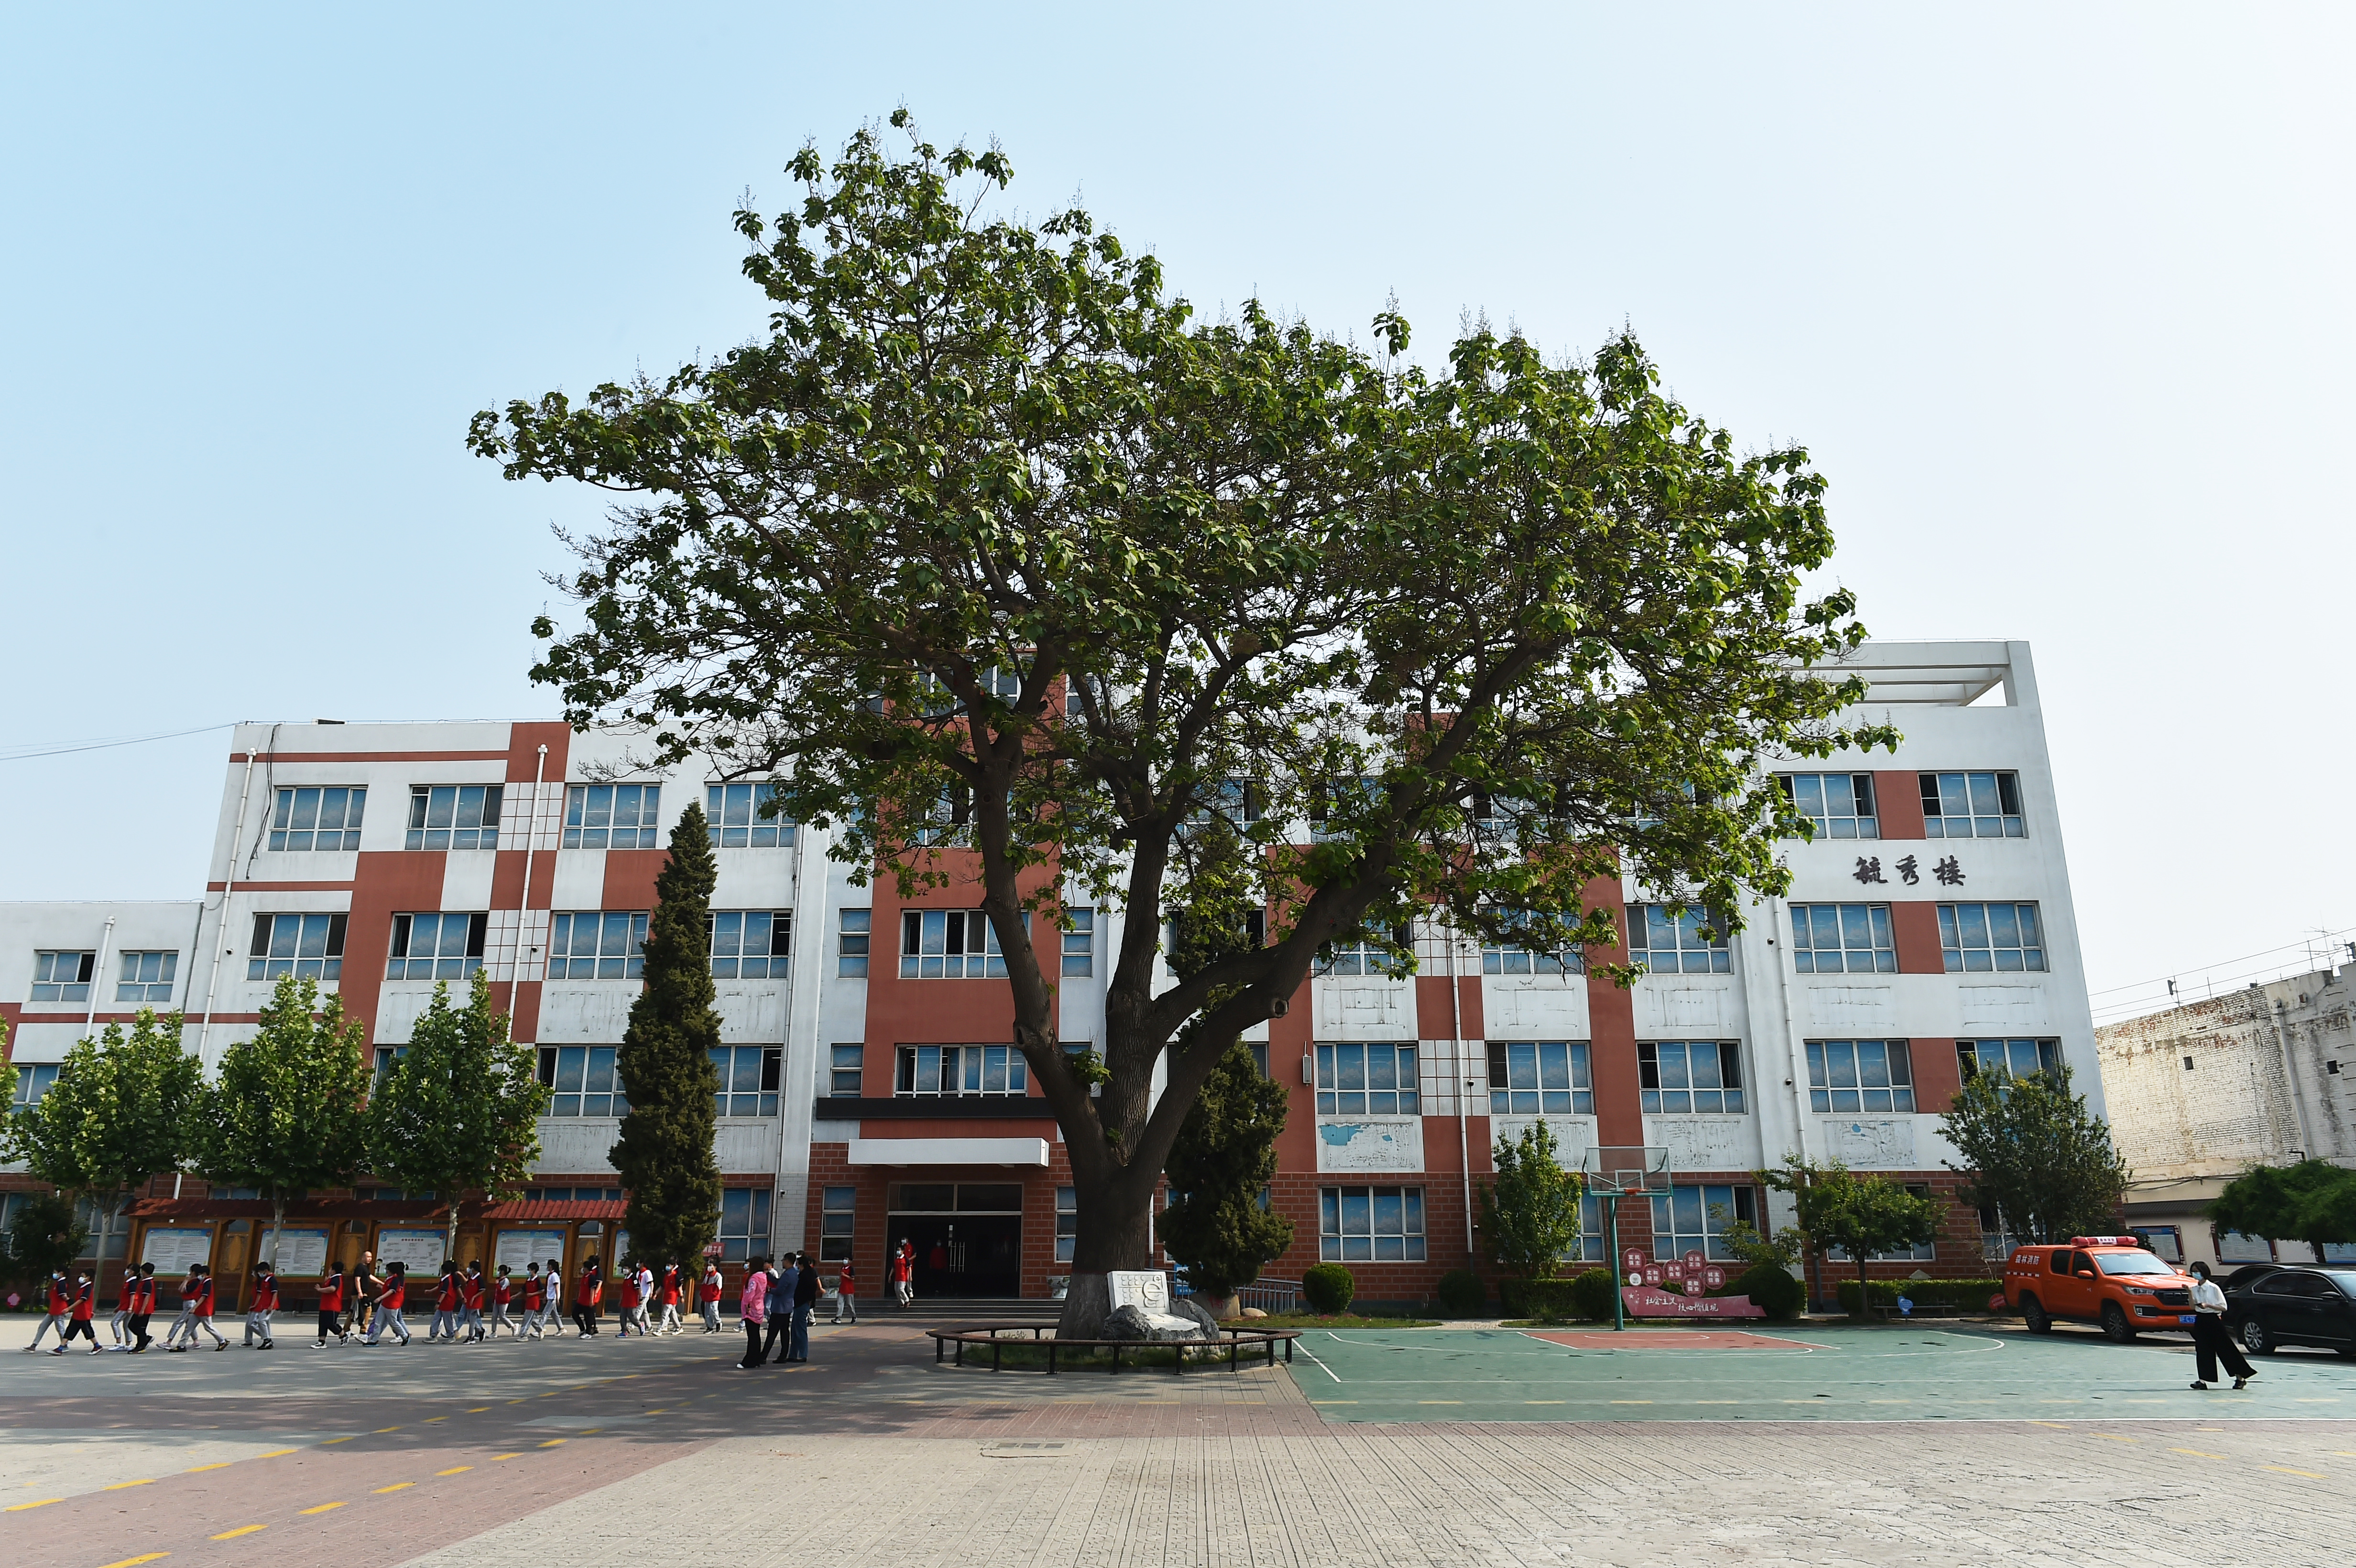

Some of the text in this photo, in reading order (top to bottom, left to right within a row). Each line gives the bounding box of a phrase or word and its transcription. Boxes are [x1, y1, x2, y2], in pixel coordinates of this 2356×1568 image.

[1853, 854, 1966, 886] 毓秀楼
[2015, 1254, 2040, 1265] 森林消防
[1646, 1296, 1677, 1305] 社会主义
[1678, 1303, 1719, 1312] 核心价值观
